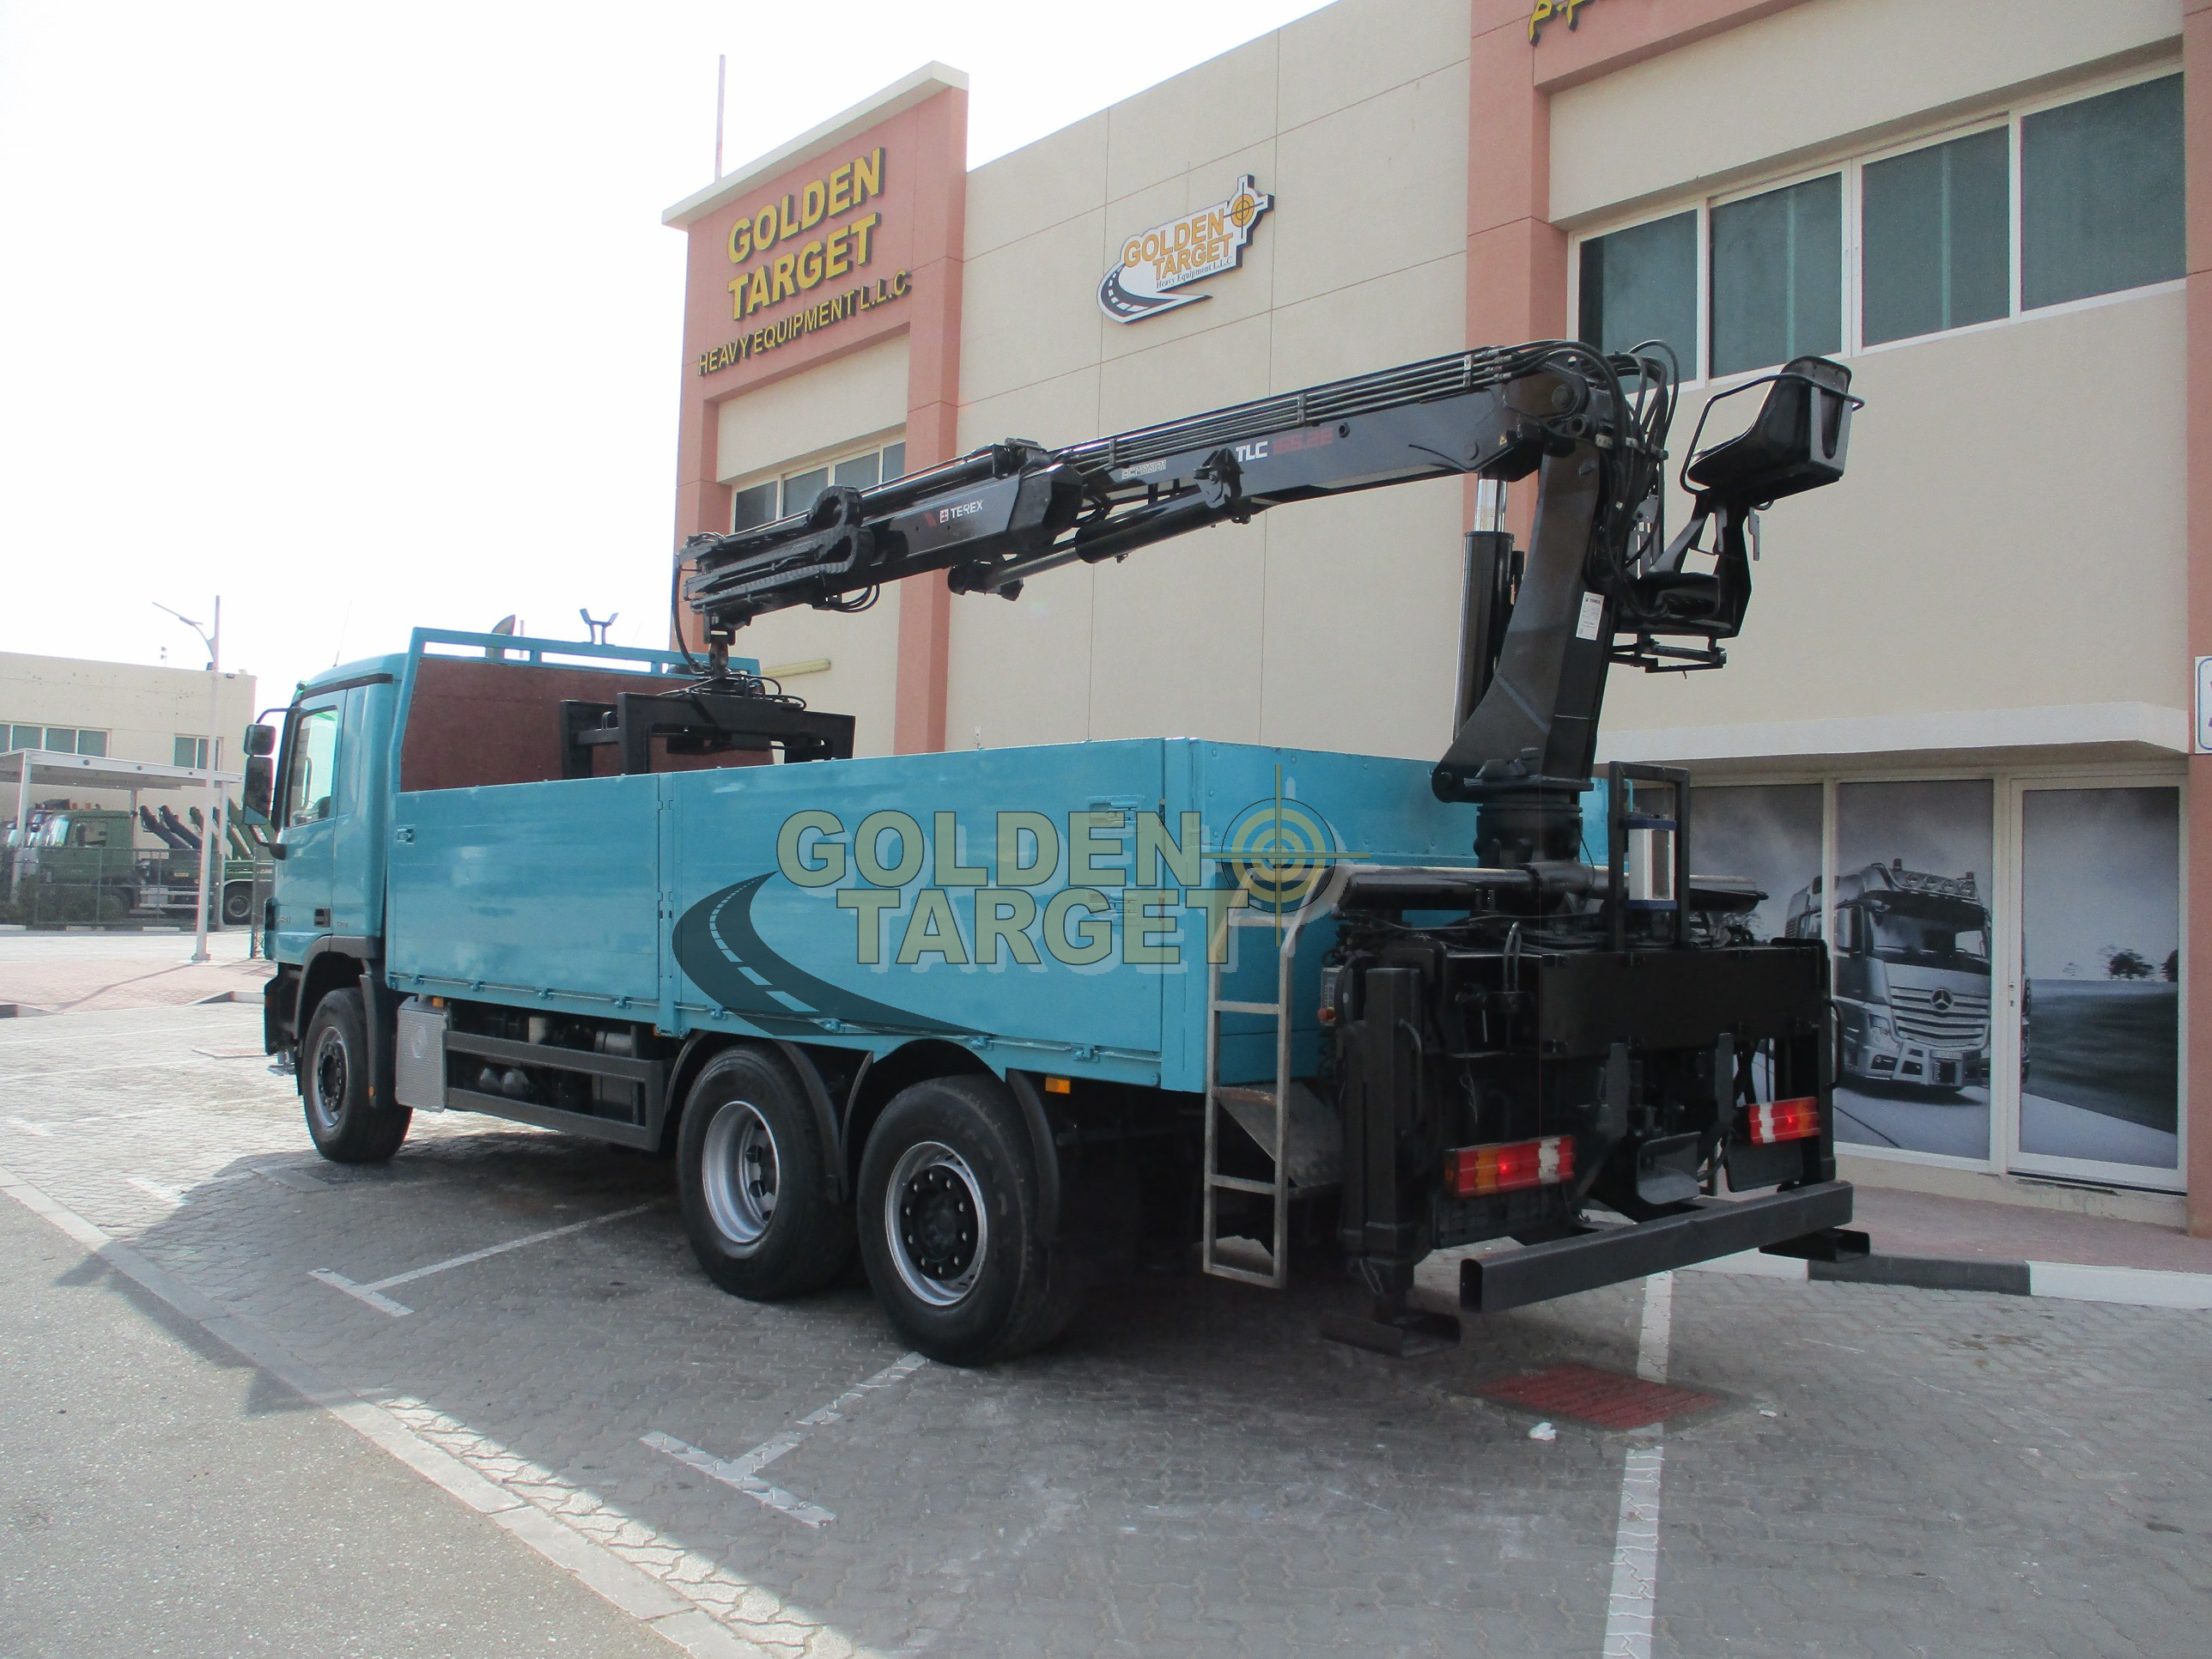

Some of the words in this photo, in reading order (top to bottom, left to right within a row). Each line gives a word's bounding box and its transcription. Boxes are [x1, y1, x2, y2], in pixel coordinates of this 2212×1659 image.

[727, 147, 884, 264] GOLDEN
[1123, 209, 1224, 268] GOLDEN
[1152, 233, 1234, 281] TARGET
[727, 212, 879, 321] TARGET
[1156, 276, 1176, 289] Heavy
[1176, 264, 1212, 280] Equipment
[698, 334, 753, 376] HEAVY
[752, 289, 859, 354] EQUIPMENT
[860, 270, 911, 311] L.L.C
[1235, 441, 1268, 463] TLC
[950, 500, 983, 519] TEREX
